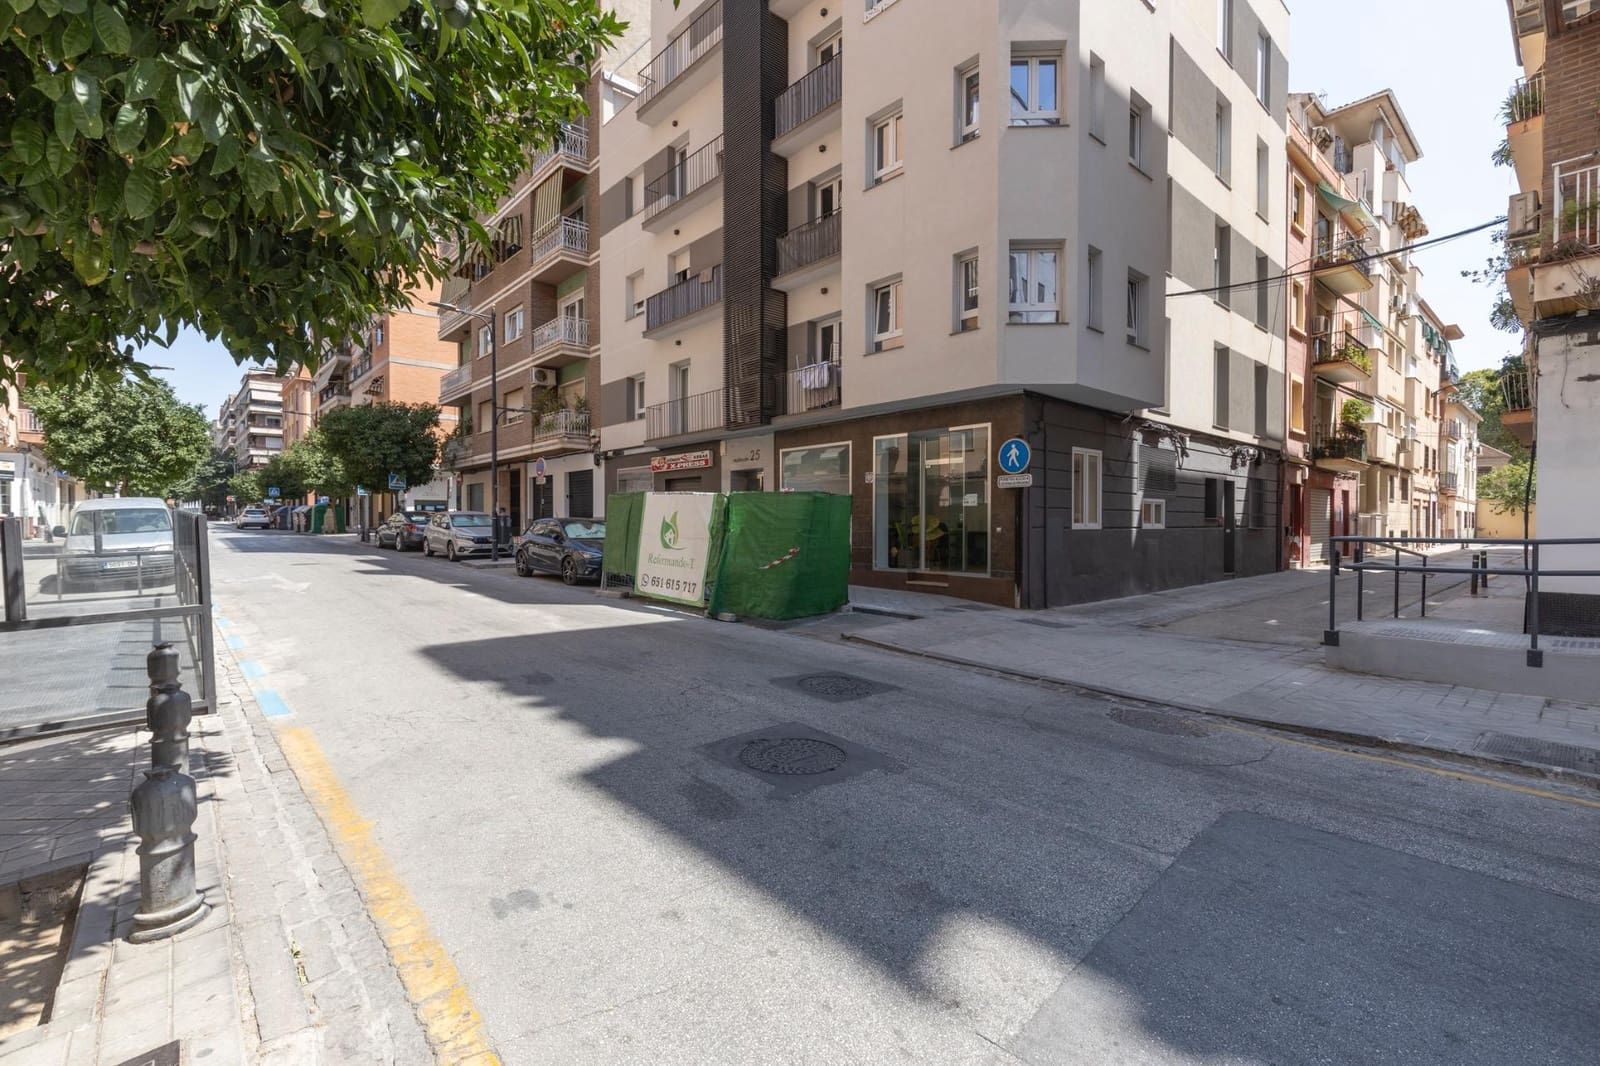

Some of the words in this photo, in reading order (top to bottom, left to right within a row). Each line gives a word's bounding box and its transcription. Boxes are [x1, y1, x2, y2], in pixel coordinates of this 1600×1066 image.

[750, 449, 761, 461] 25
[651, 576, 664, 588] 651
[665, 578, 681, 590] 615
[682, 581, 697, 593] 717
